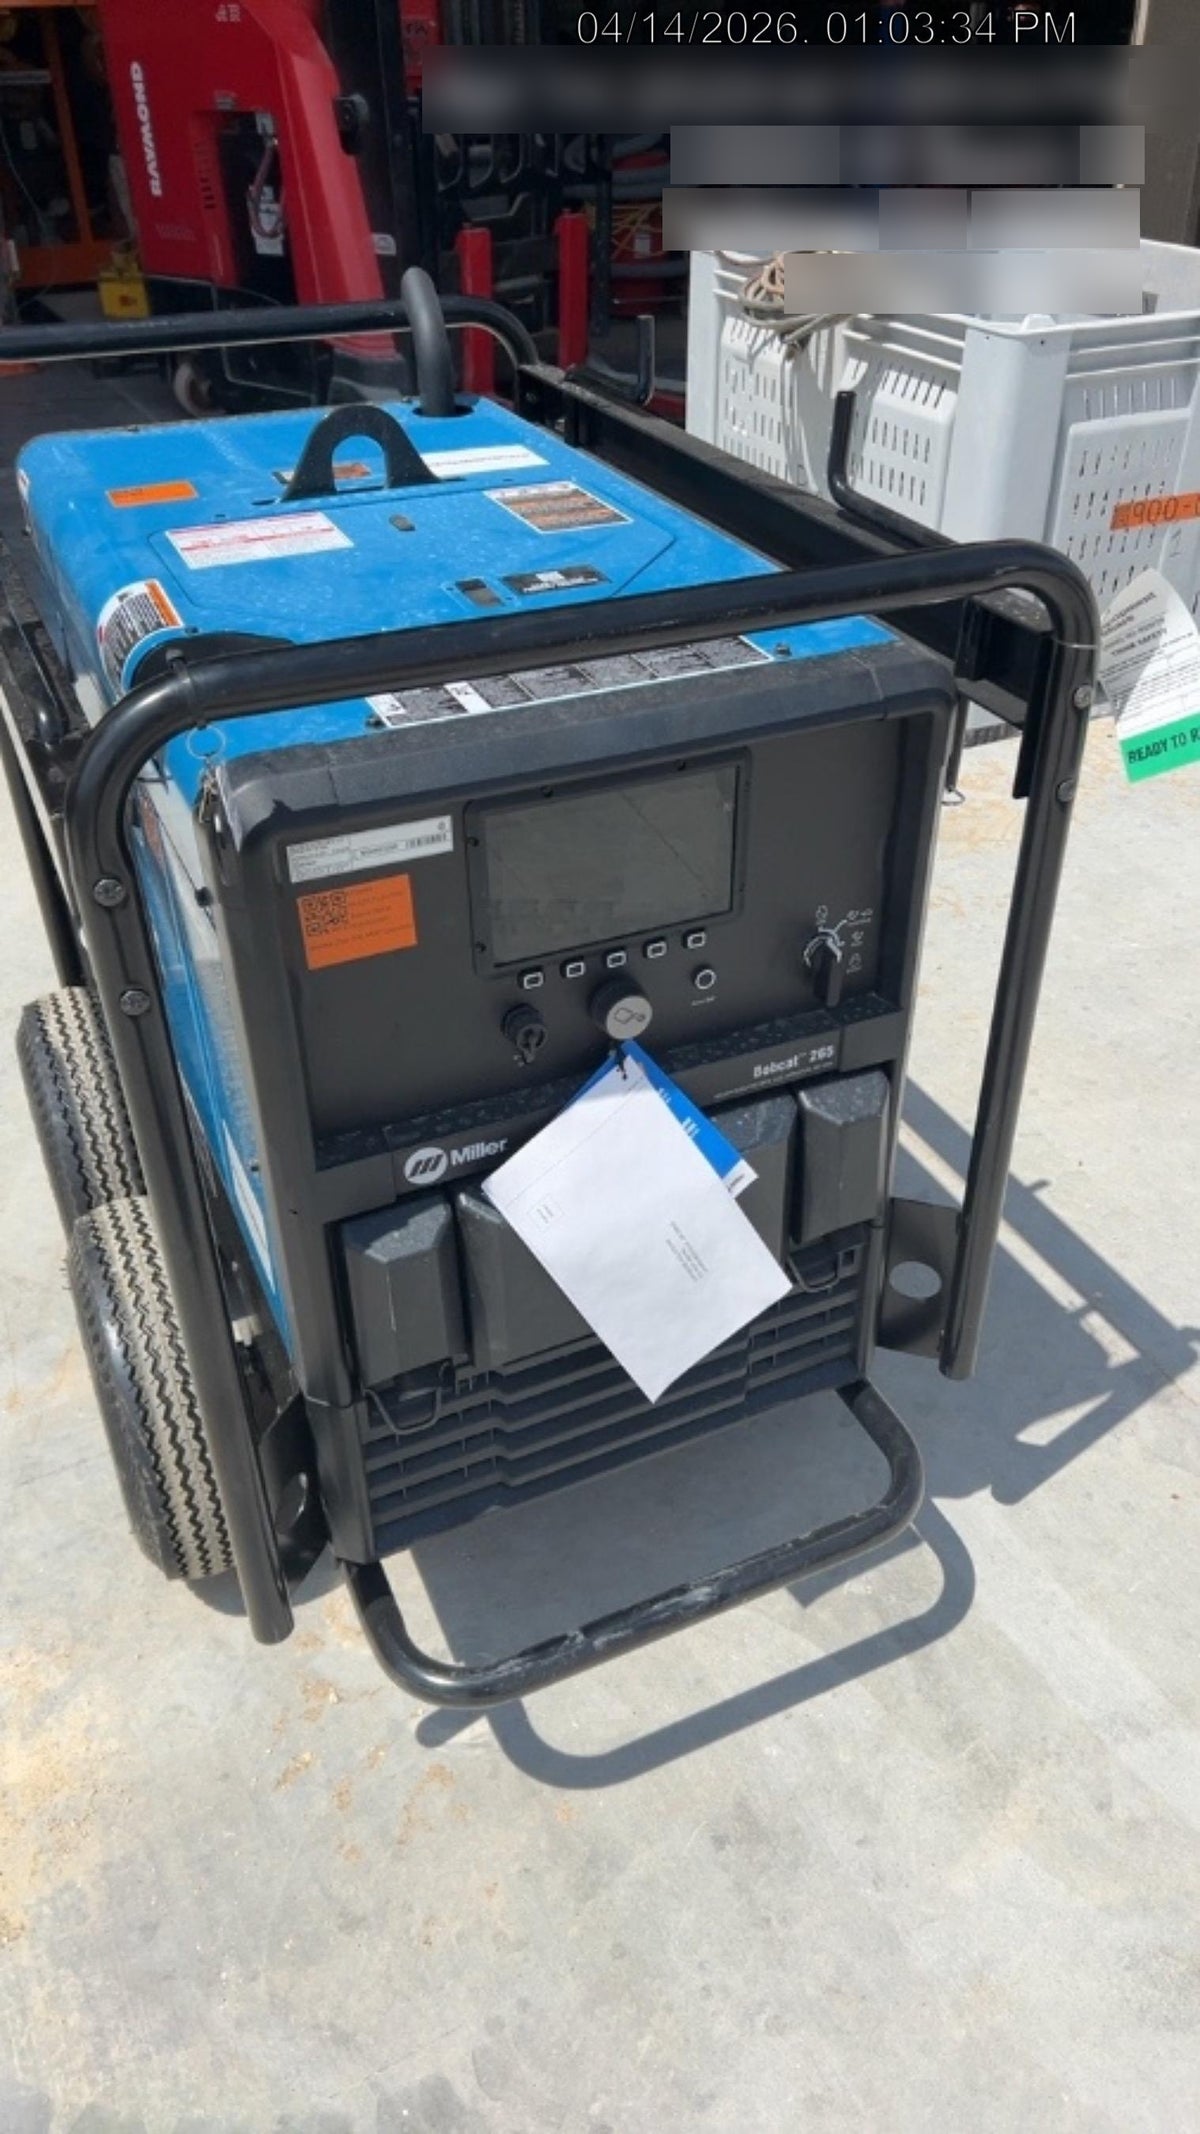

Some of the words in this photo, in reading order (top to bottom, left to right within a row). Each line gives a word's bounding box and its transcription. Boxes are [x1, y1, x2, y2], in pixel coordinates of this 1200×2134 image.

[130, 61, 162, 196] RAYMOND
[1128, 738, 1168, 764] READY
[1169, 732, 1187, 749] TO
[809, 1045, 834, 1063] 265
[450, 1139, 508, 1167] Miller
